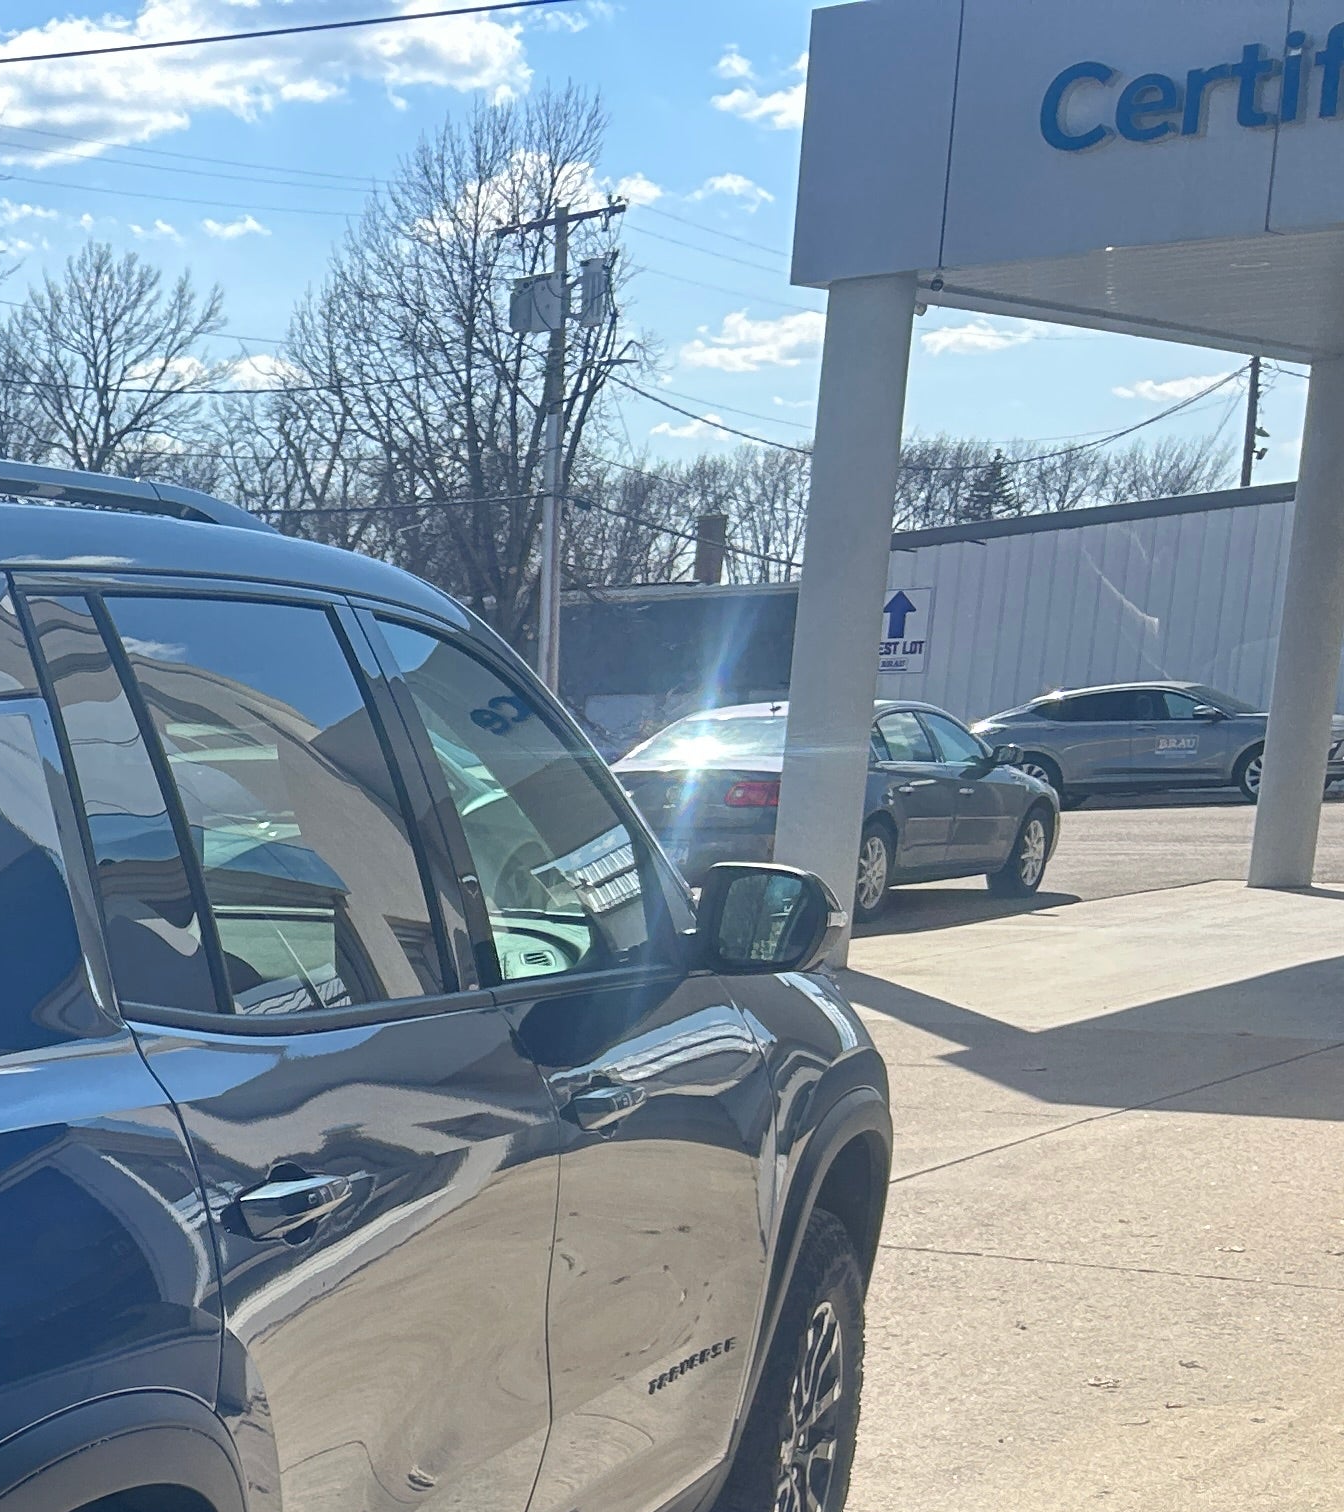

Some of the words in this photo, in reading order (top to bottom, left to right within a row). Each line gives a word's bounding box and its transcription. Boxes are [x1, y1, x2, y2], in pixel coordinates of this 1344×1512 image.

[1040, 21, 1344, 151] Certif
[879, 641, 900, 656] EST
[902, 640, 925, 655] LOT
[1157, 738, 1196, 750] BRAU
